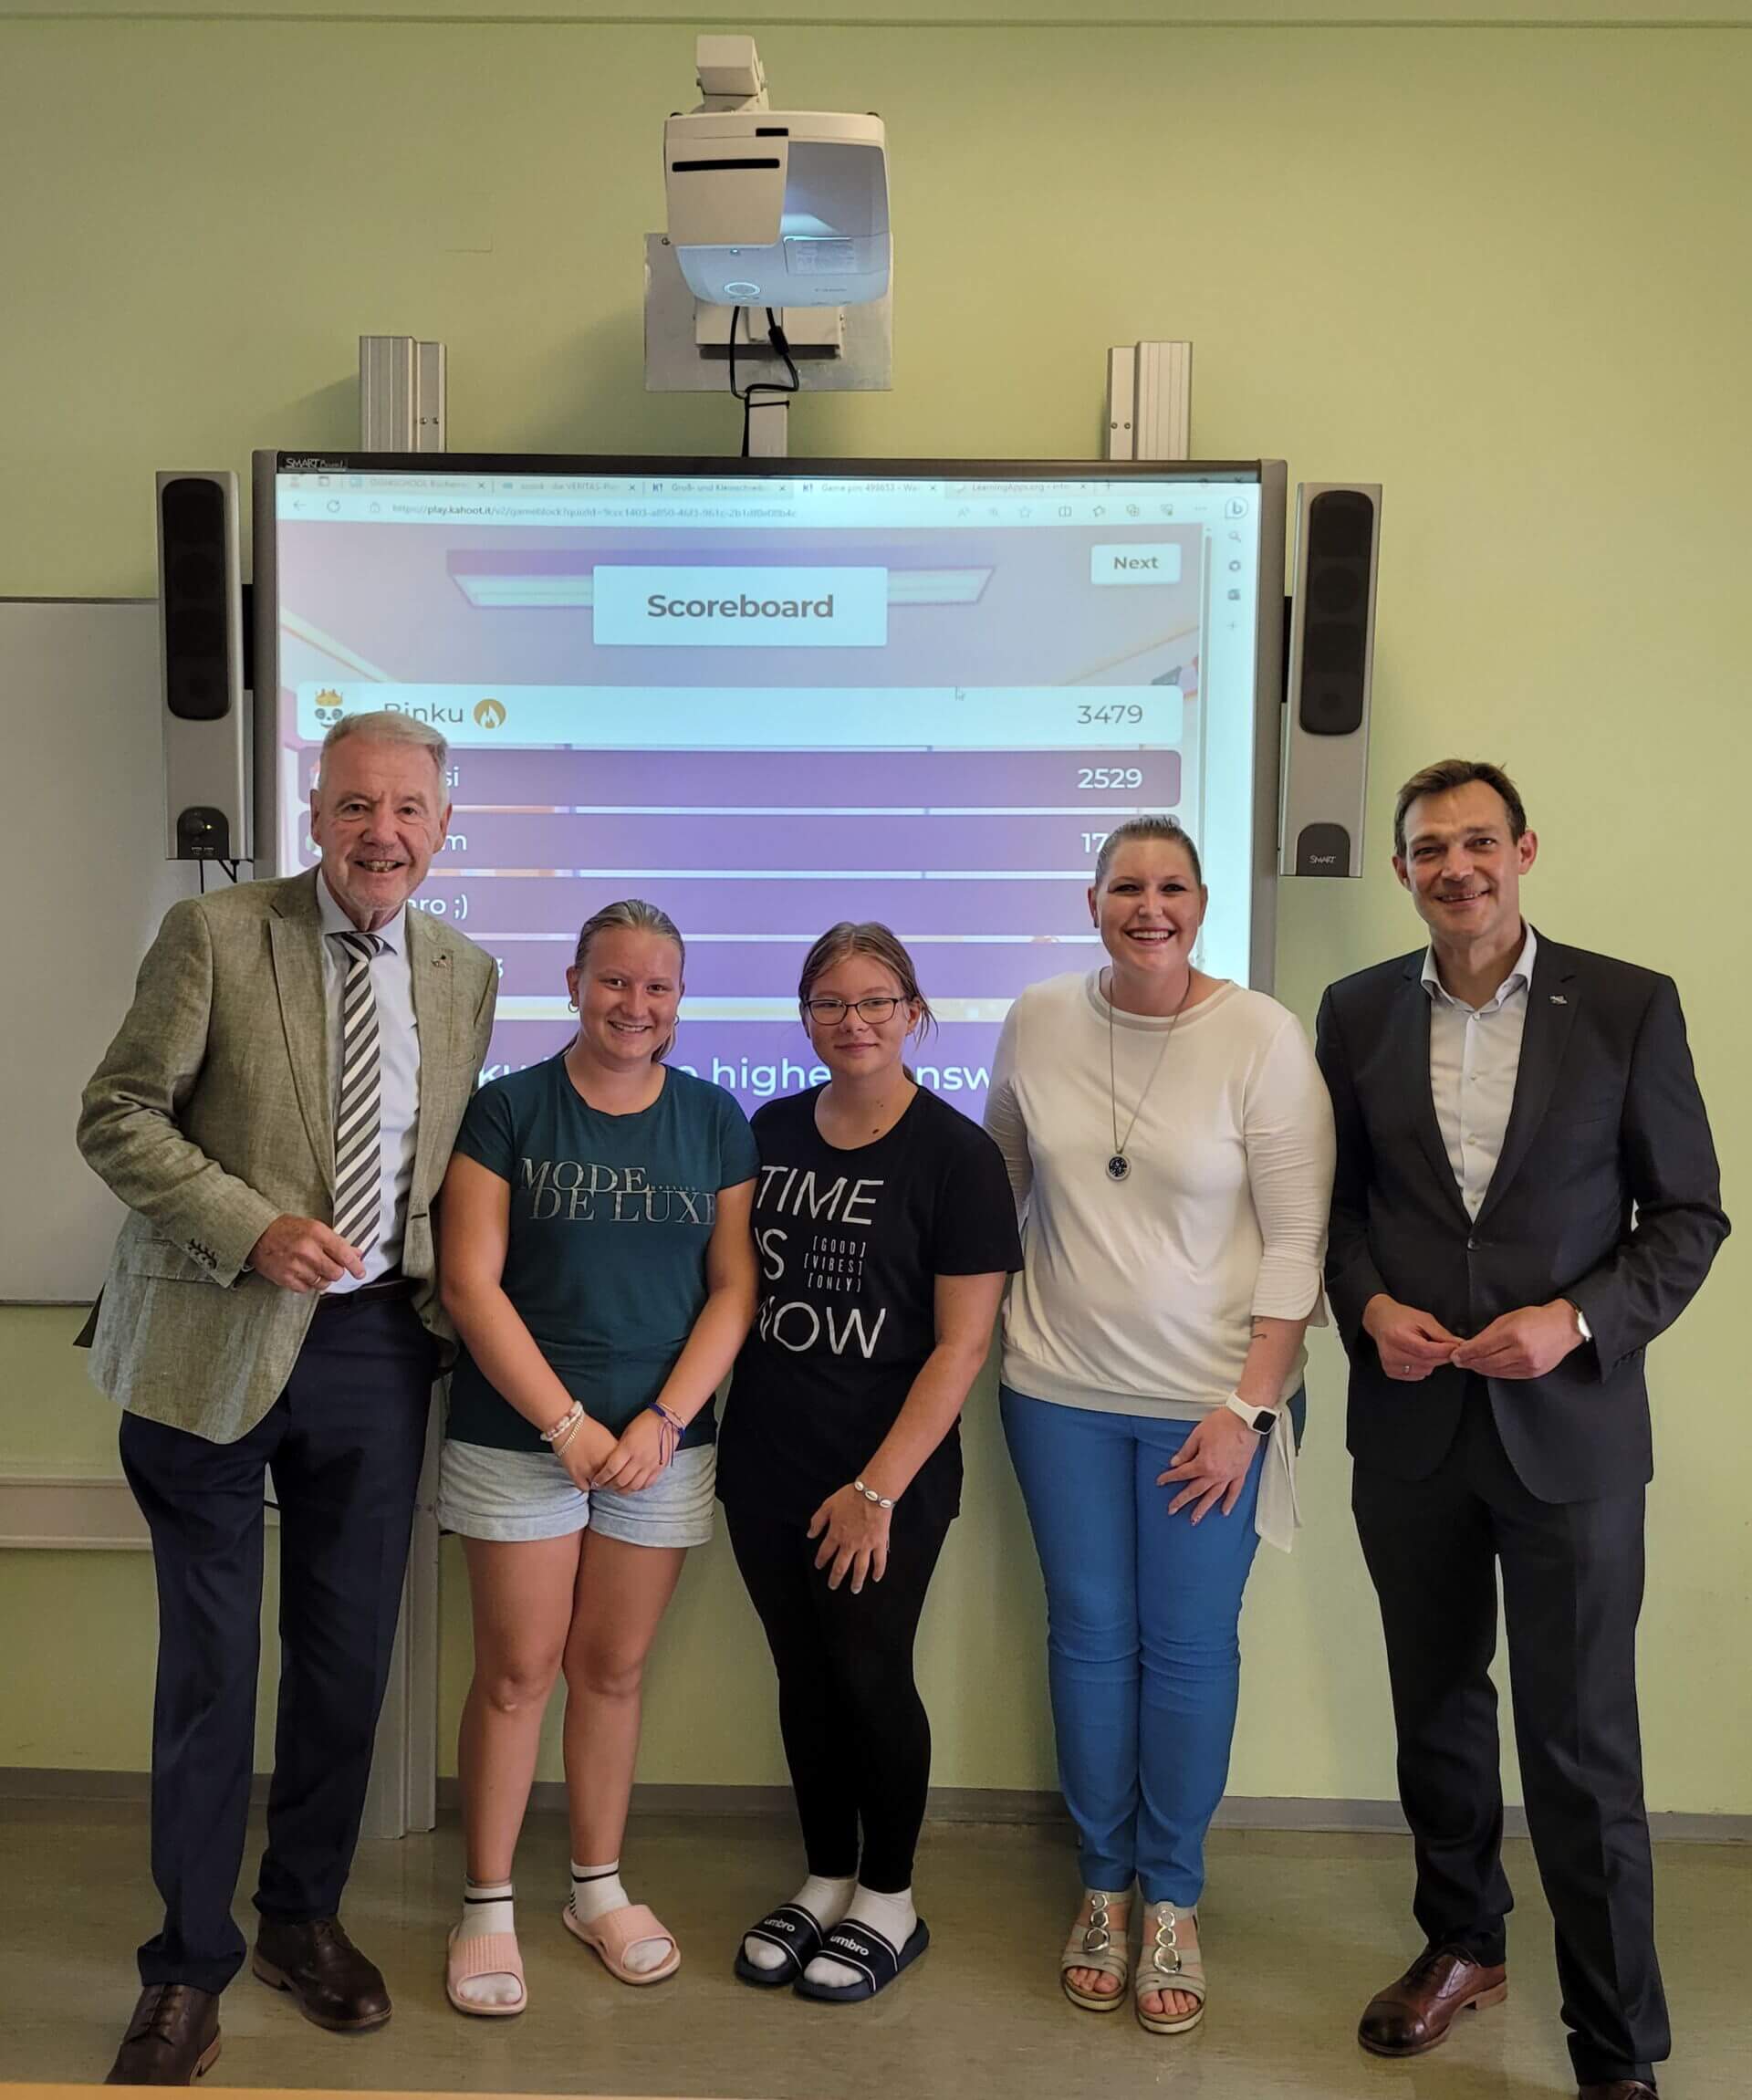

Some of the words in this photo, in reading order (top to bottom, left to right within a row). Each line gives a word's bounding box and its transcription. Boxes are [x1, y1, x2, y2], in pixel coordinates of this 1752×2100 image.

[1113, 556, 1159, 570] Next
[647, 593, 834, 618] Scoreboard
[1077, 705, 1143, 725] 3479
[1077, 768, 1143, 789] 2529
[712, 1058, 832, 1097] highe
[520, 1156, 656, 1194] MODE
[529, 1186, 595, 1221] DE
[756, 1165, 884, 1226] TIME
[764, 1917, 796, 1933] umbro
[829, 1935, 870, 1957] umbro
